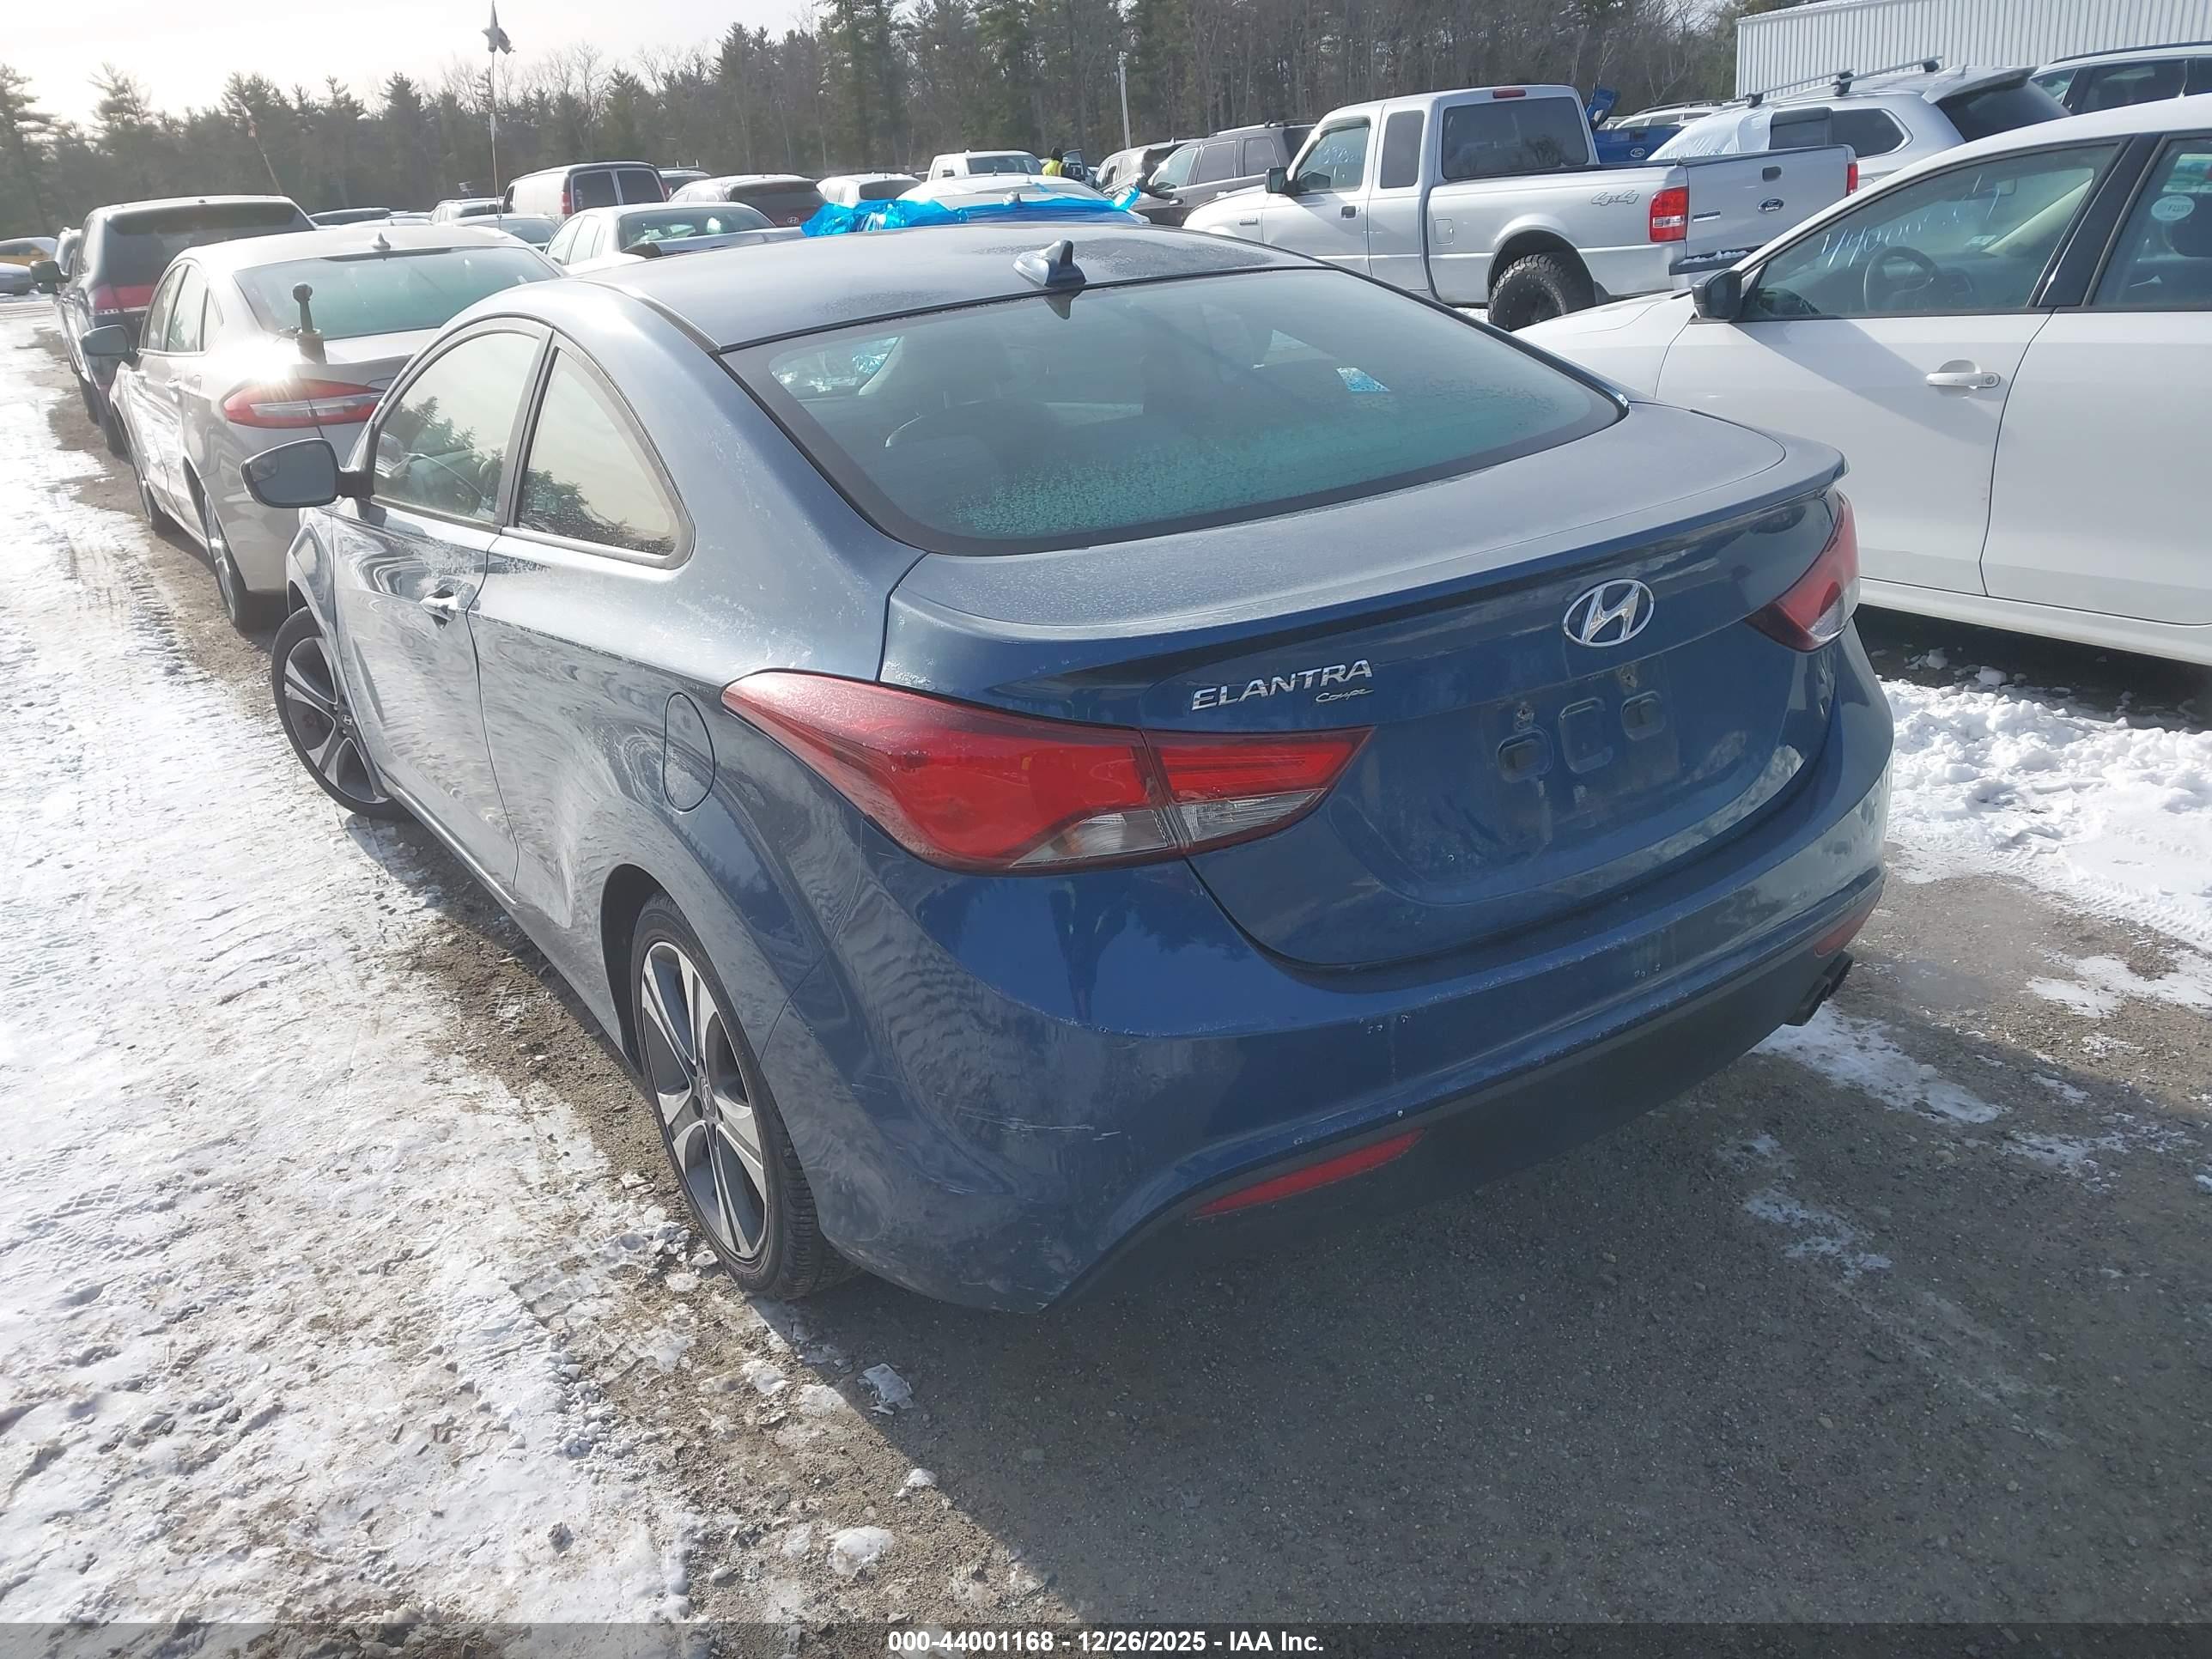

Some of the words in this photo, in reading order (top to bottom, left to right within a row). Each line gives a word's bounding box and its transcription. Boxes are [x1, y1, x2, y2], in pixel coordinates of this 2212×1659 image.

[1590, 189, 1640, 206] 4x4
[1191, 659, 1373, 711] ELANTRA
[1315, 688, 1374, 703] Coupe
